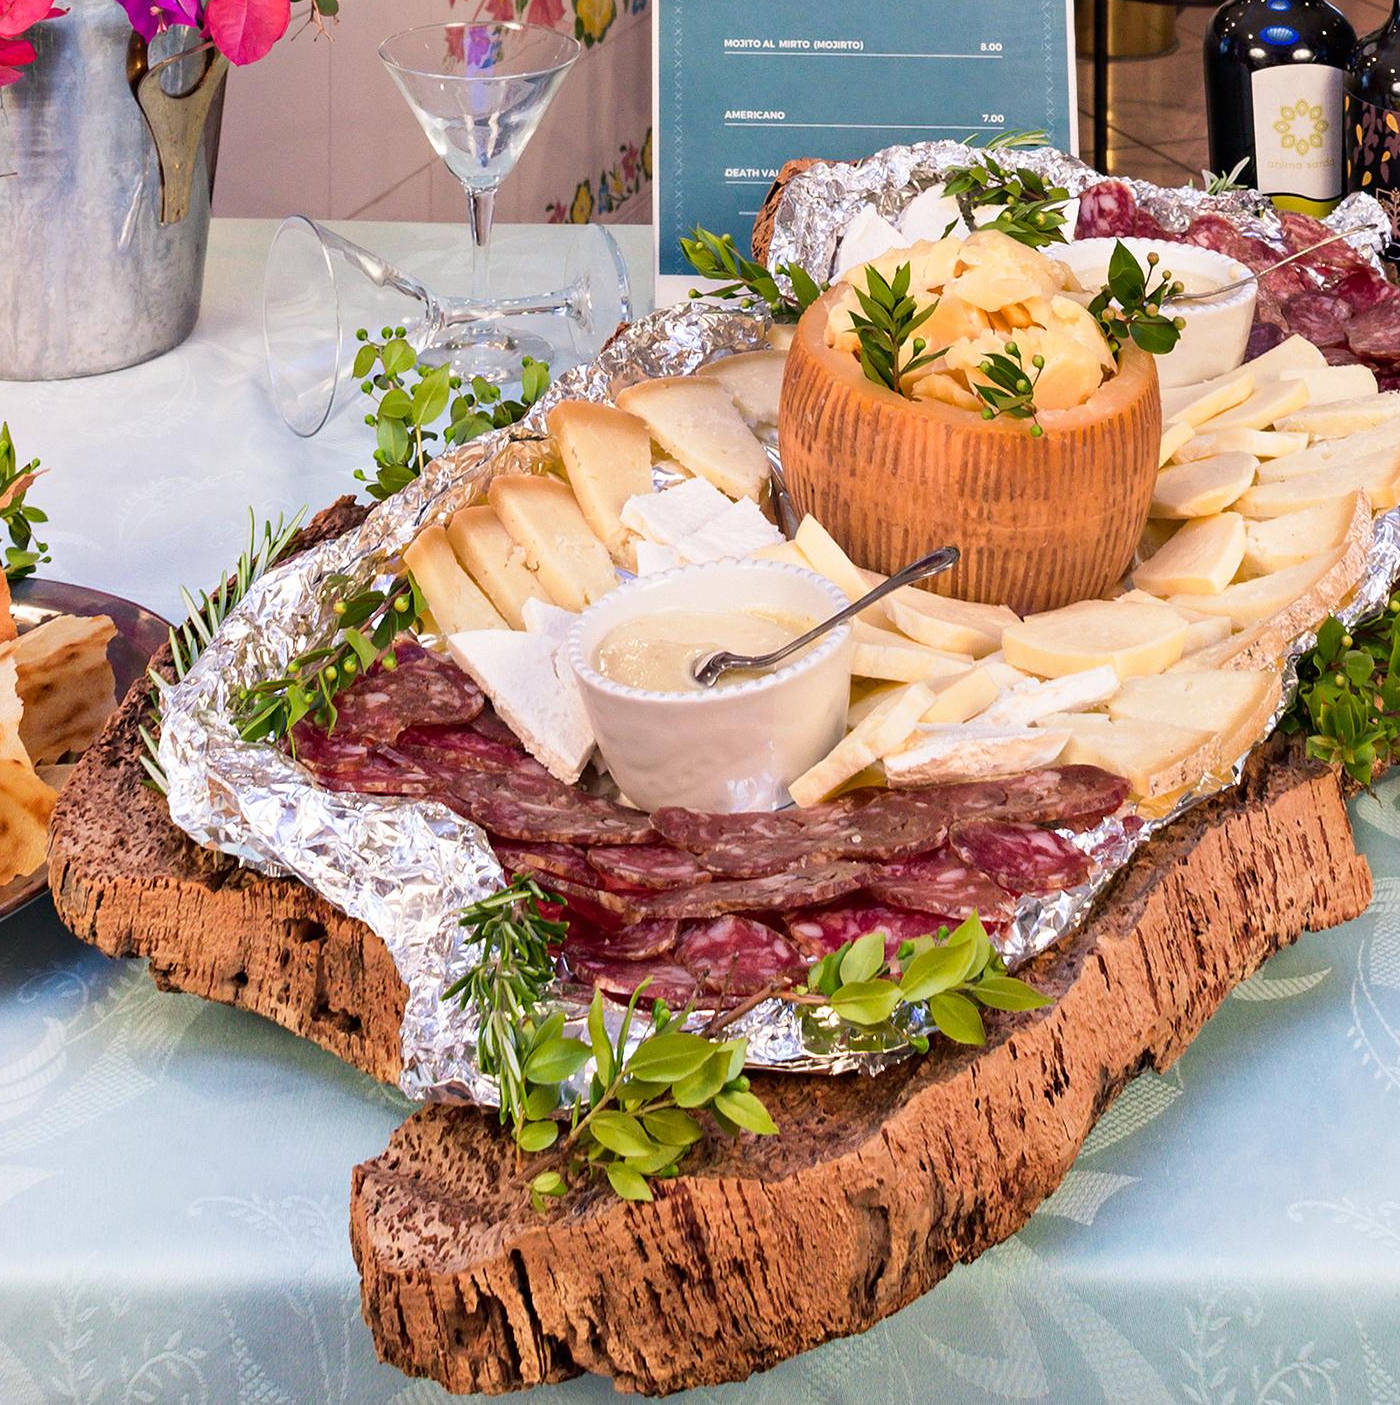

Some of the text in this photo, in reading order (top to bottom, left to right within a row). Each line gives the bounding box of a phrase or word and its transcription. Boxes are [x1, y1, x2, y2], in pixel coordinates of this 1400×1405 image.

[724, 38, 864, 51] MOJITO AL MIRTO (MOJIRTO)
[980, 42, 1002, 52] 8.00
[724, 109, 785, 120] AMERICANO
[982, 113, 1004, 124] 7.00
[1267, 160, 1303, 169] anima
[725, 168, 760, 178] DEATH
